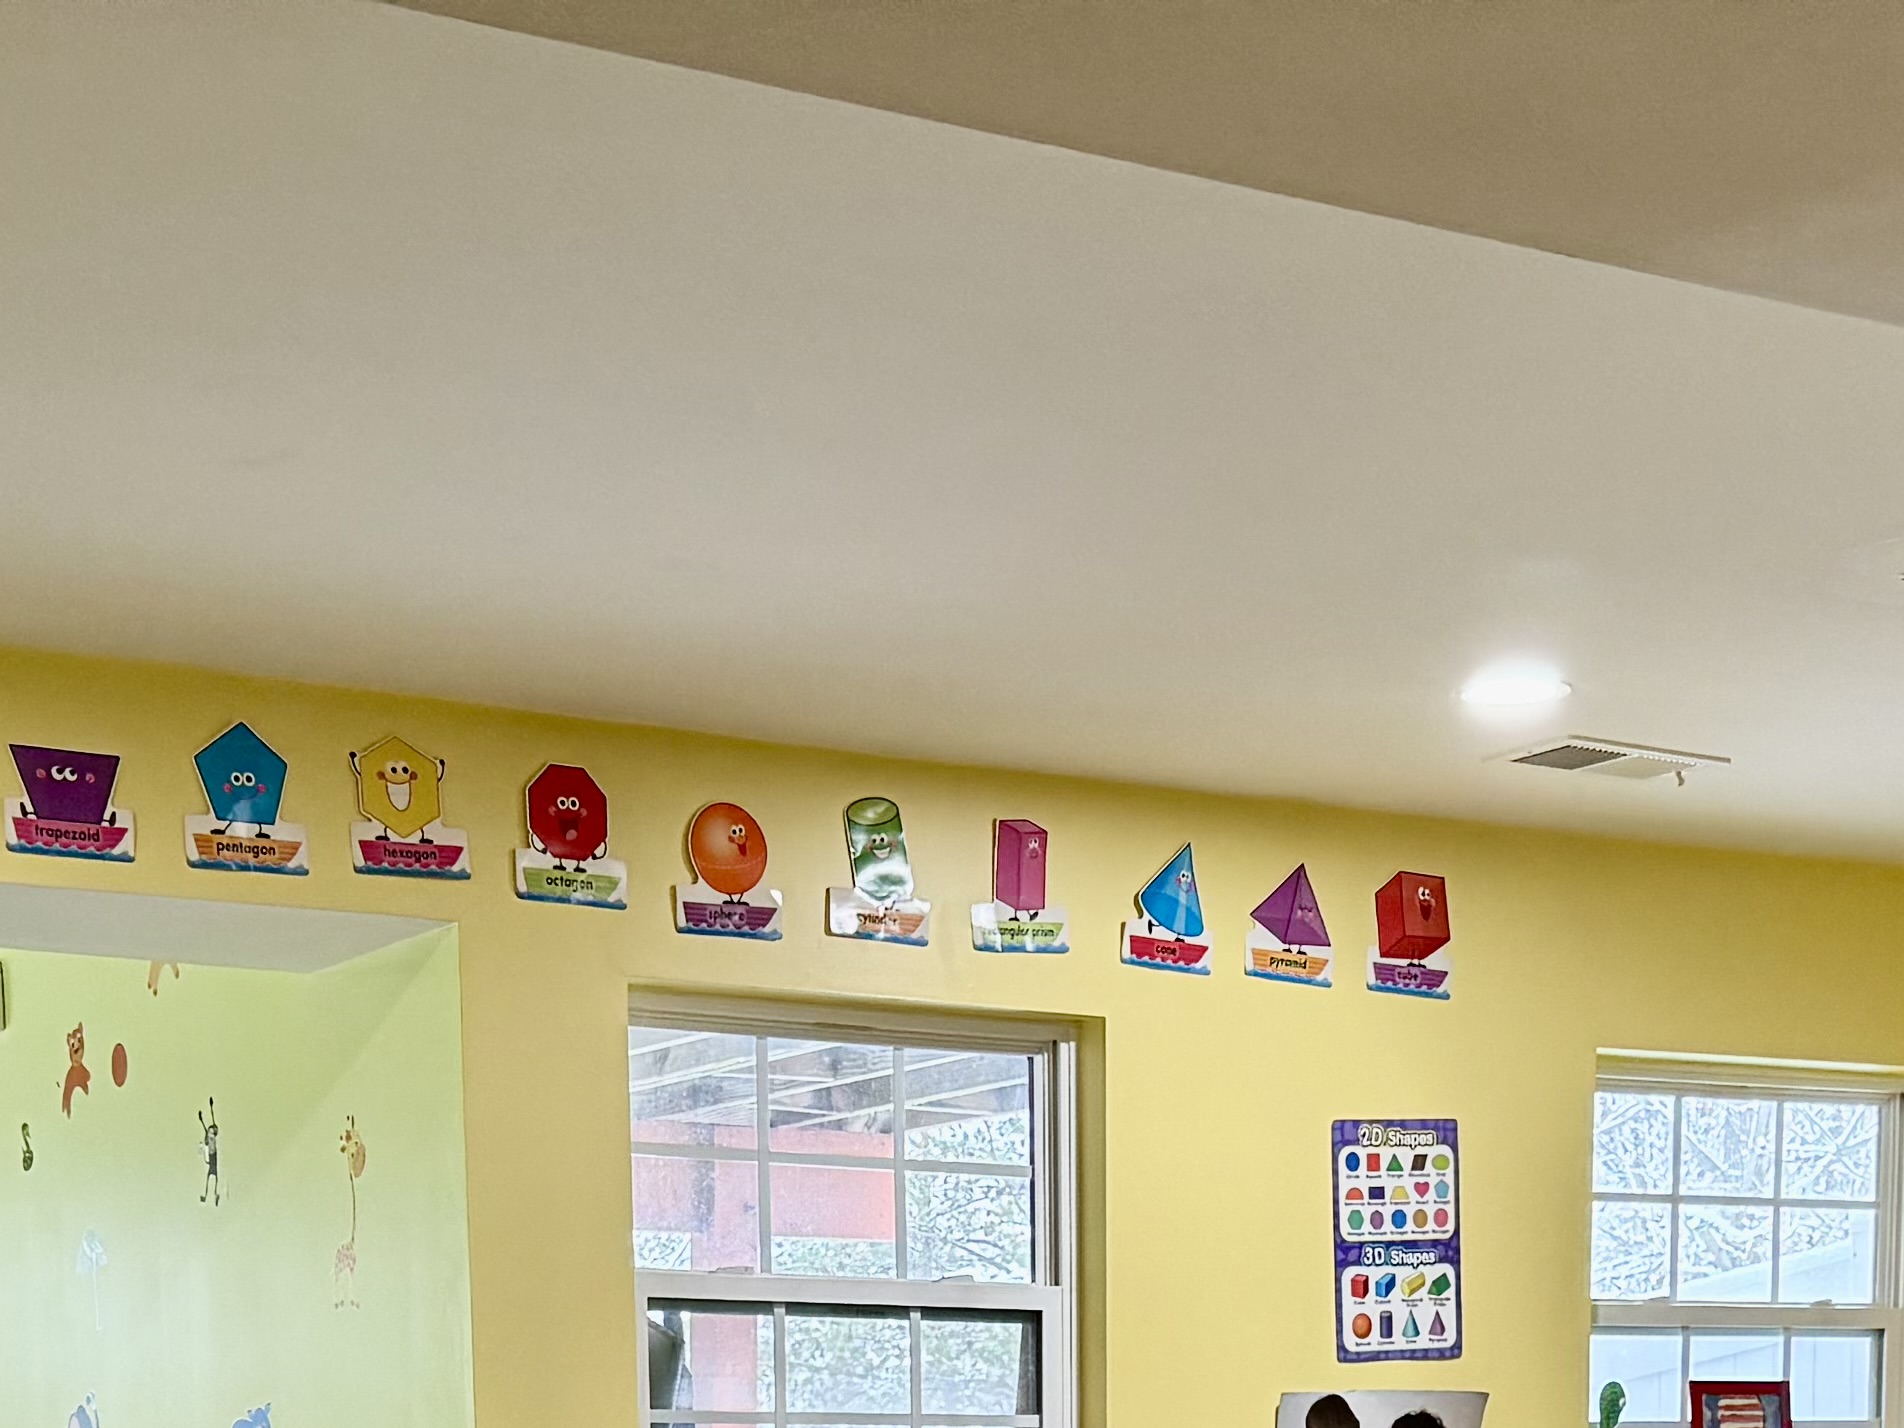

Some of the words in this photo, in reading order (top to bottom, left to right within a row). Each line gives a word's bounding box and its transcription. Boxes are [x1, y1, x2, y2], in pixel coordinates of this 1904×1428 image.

[35, 825, 100, 843] trapezoid
[217, 842, 276, 858] pentagon
[384, 847, 437, 863] hexagon
[546, 876, 593, 892] octagon
[708, 908, 746, 924] sphere
[1156, 944, 1176, 956] cone
[1269, 955, 1308, 970] pyramid
[1359, 1125, 1383, 1147] 2D
[1386, 1130, 1435, 1149] Shapes
[1363, 1248, 1385, 1266] 3D
[1390, 1250, 1436, 1268] Shapes
